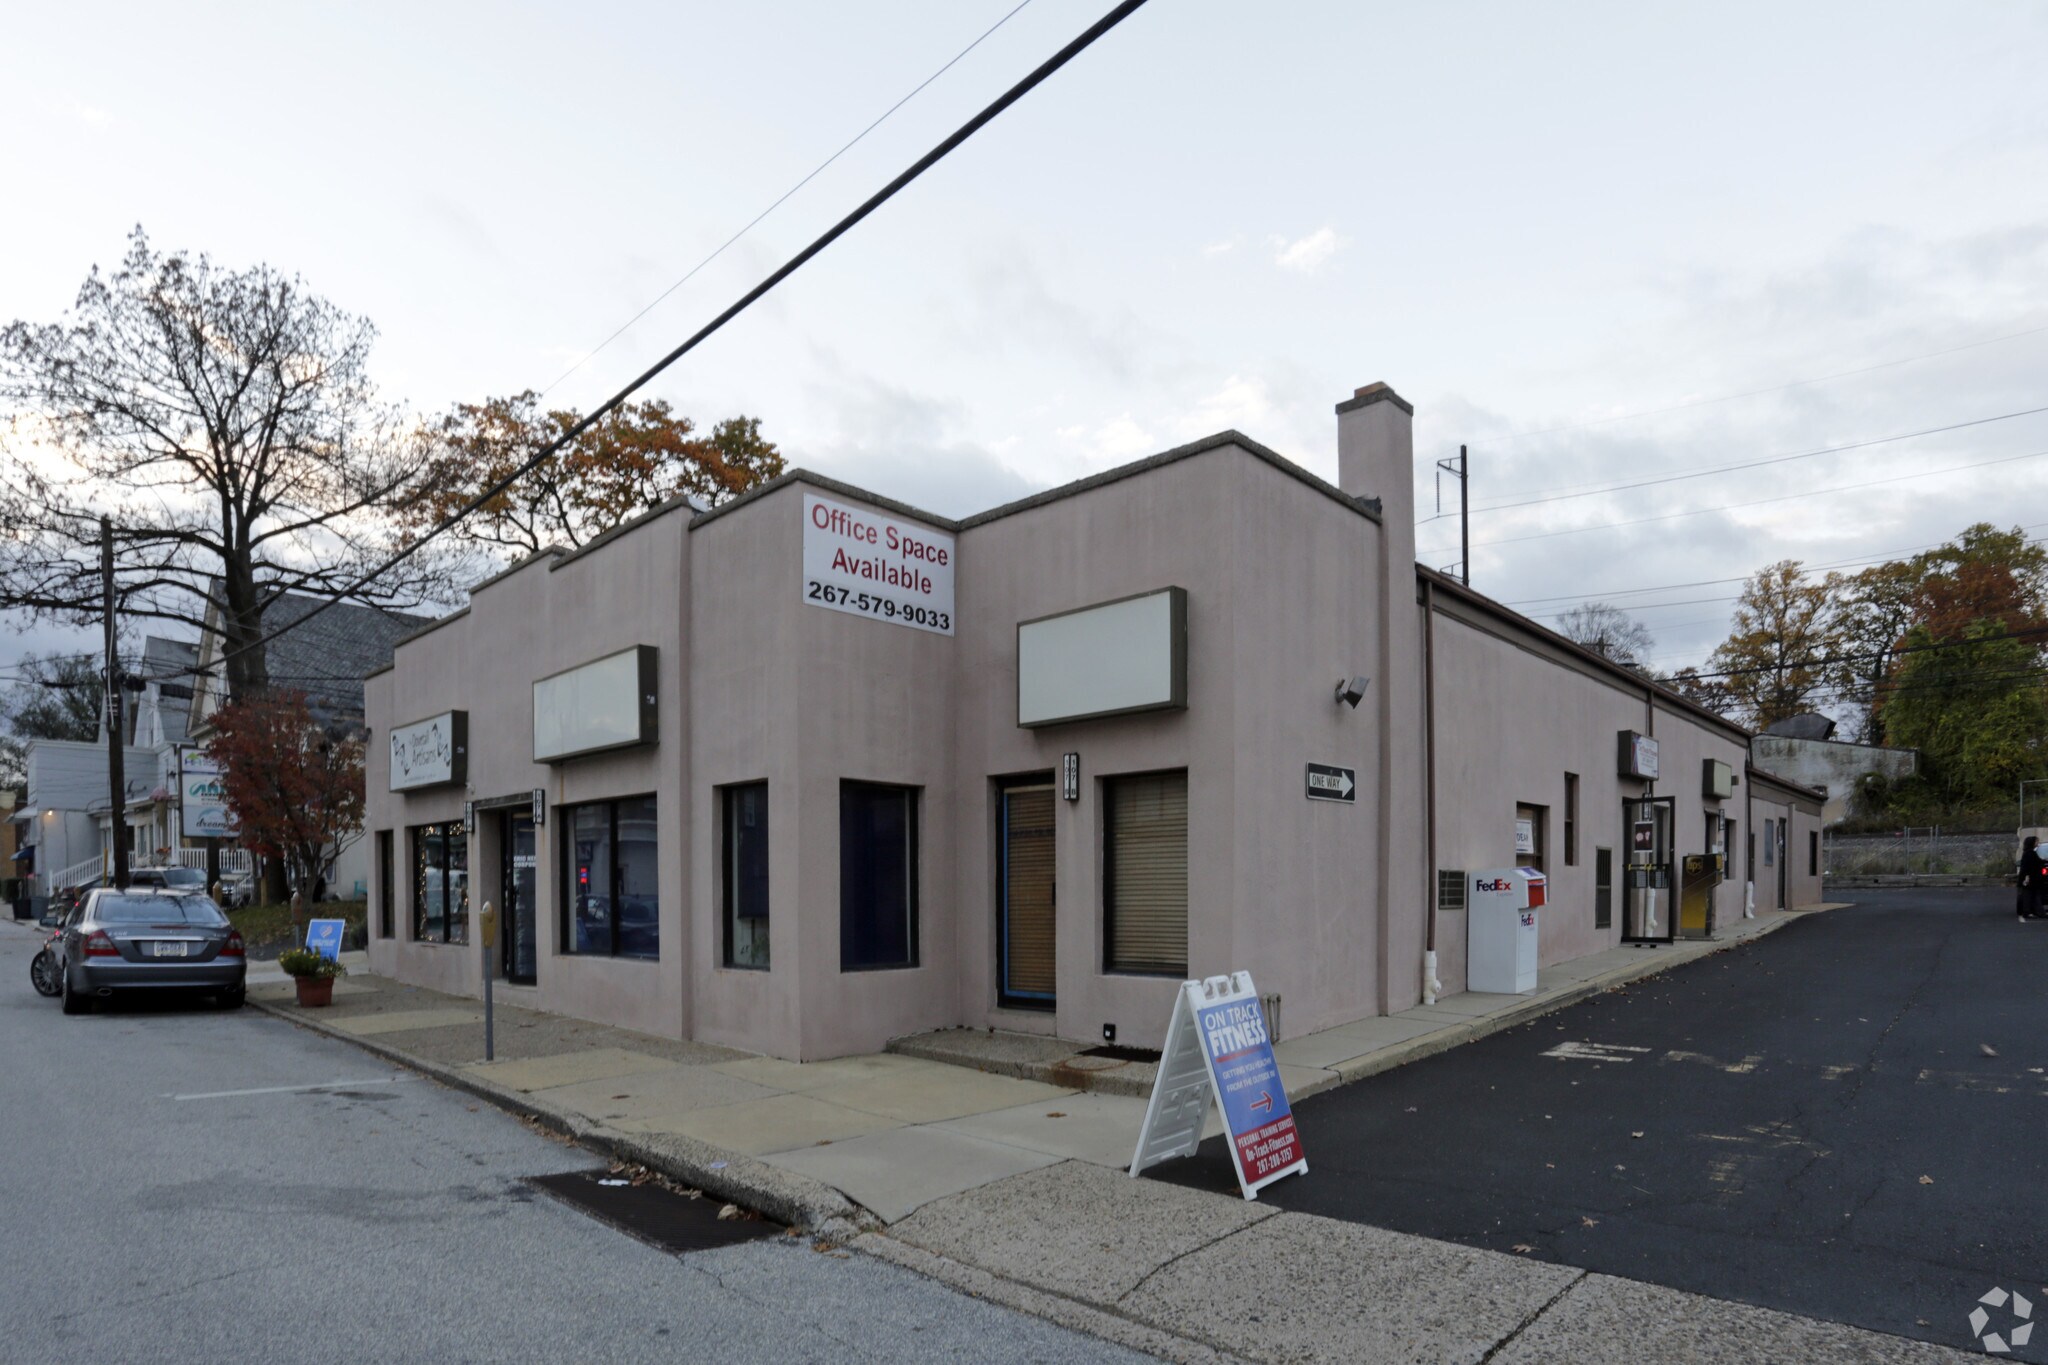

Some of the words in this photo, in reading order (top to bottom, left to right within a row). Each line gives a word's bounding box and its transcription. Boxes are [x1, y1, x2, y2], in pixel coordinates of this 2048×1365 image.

[812, 504, 877, 544] Office
[886, 526, 948, 566] Space
[831, 547, 932, 594] Available
[808, 581, 950, 630] 267-579-9033
[1312, 774, 1325, 787] ONE
[1327, 777, 1340, 789] WAY
[1688, 862, 1702, 872] ups
[1476, 879, 1511, 892] FedEx
[1521, 913, 1534, 927] FedEx
[1205, 1010, 1226, 1030] ON
[1227, 1002, 1259, 1024] TRACK
[1208, 1018, 1266, 1056] FITNESS
[1237, 1131, 1260, 1148] PERSONAL
